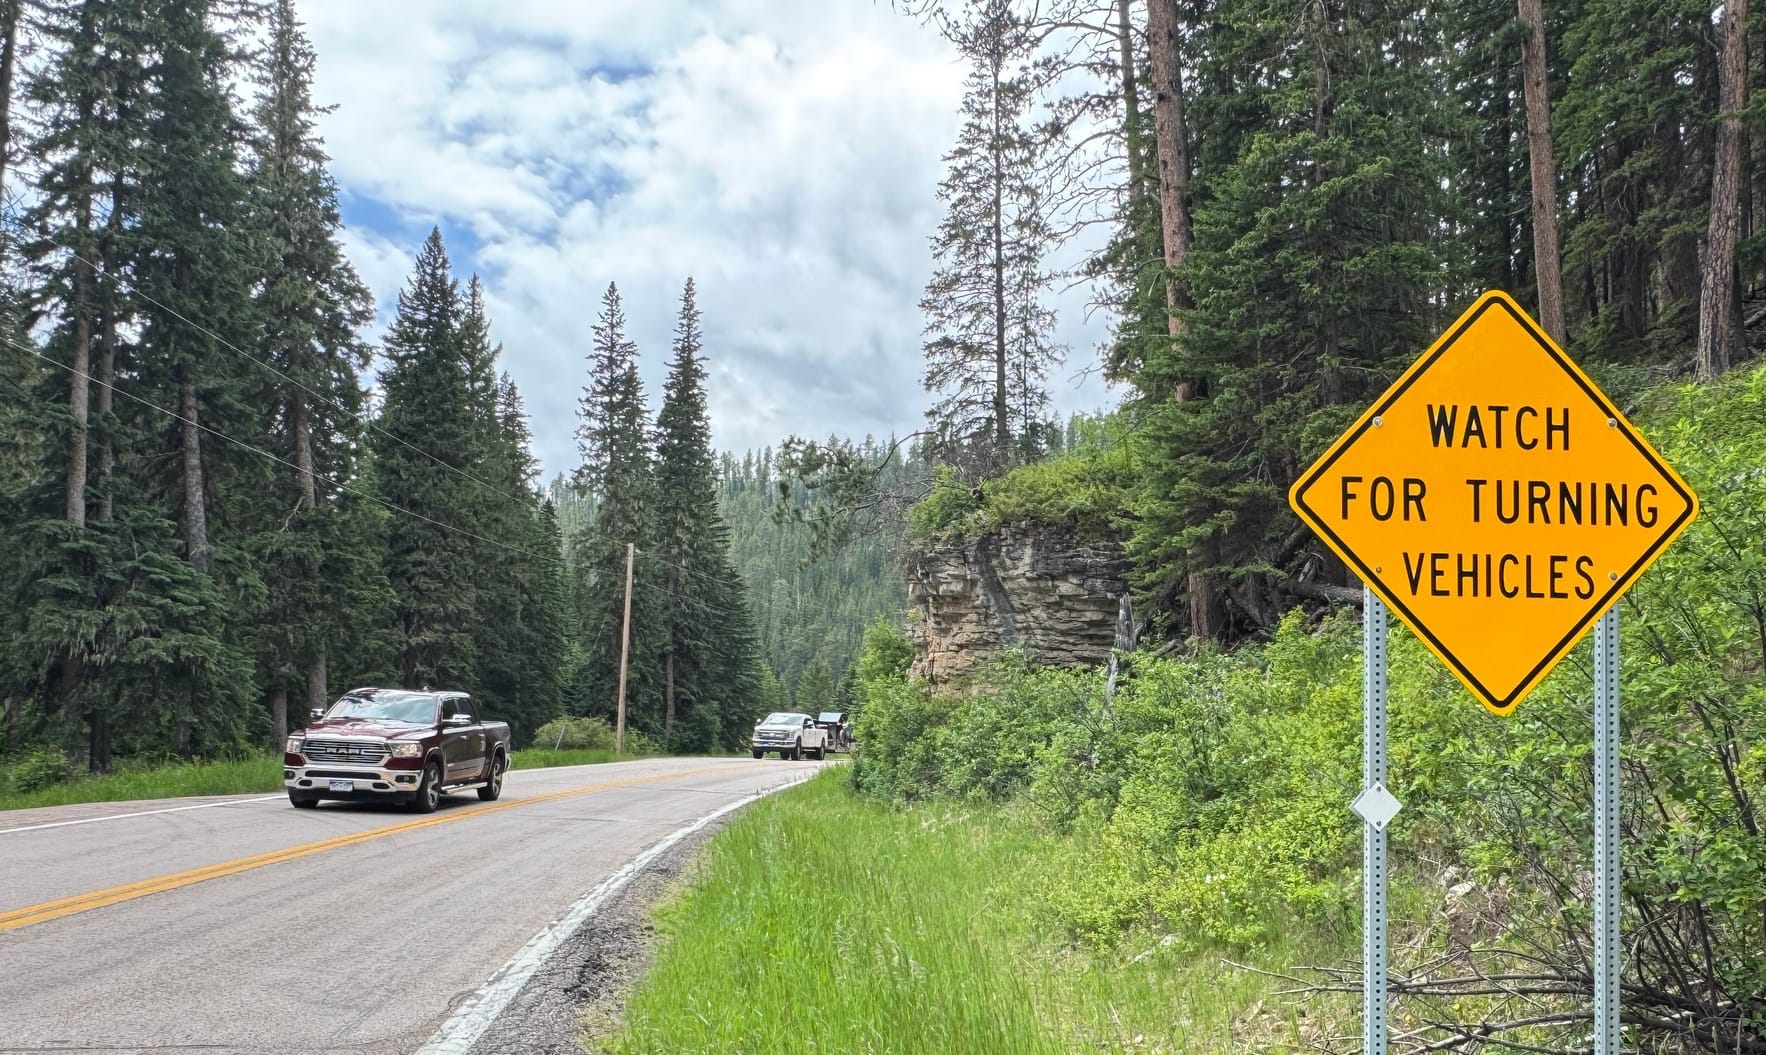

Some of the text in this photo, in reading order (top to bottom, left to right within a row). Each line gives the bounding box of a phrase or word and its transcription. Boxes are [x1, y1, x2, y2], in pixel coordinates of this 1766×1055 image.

[1427, 404, 1570, 451] WATCH
[1341, 476, 1658, 529] FOR TURNING
[1402, 552, 1596, 600] VEHICLES
